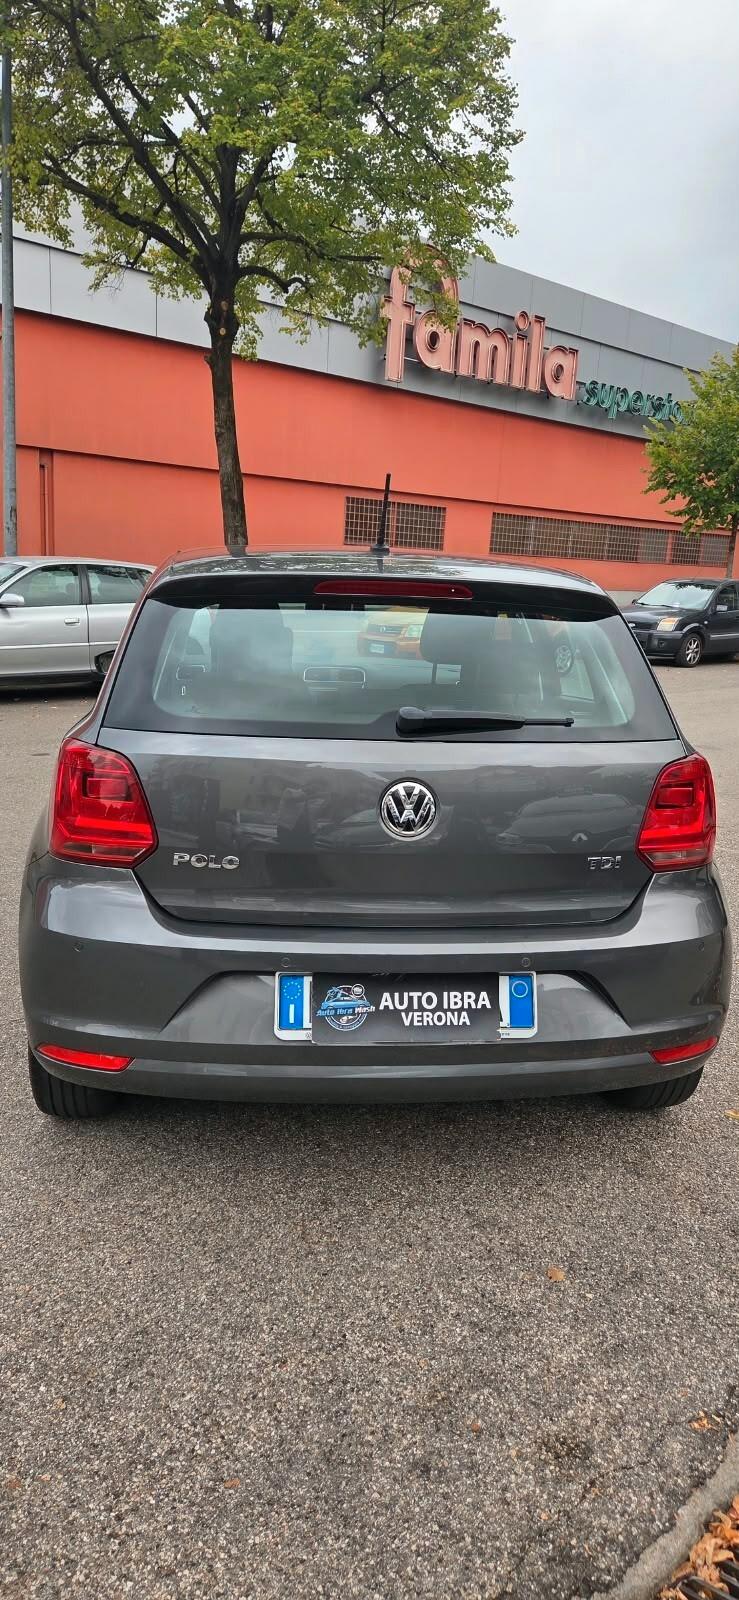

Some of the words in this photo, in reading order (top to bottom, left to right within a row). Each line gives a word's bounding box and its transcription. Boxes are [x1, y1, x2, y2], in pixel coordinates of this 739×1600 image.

[381, 244, 579, 401] famila
[172, 852, 240, 870] POLO
[587, 855, 622, 870] TDI
[379, 991, 438, 1010] AUTO
[443, 991, 492, 1009] IBRA
[316, 1008, 335, 1017] Auto
[354, 1005, 376, 1014] Wash
[401, 1011, 470, 1026] VERONA
